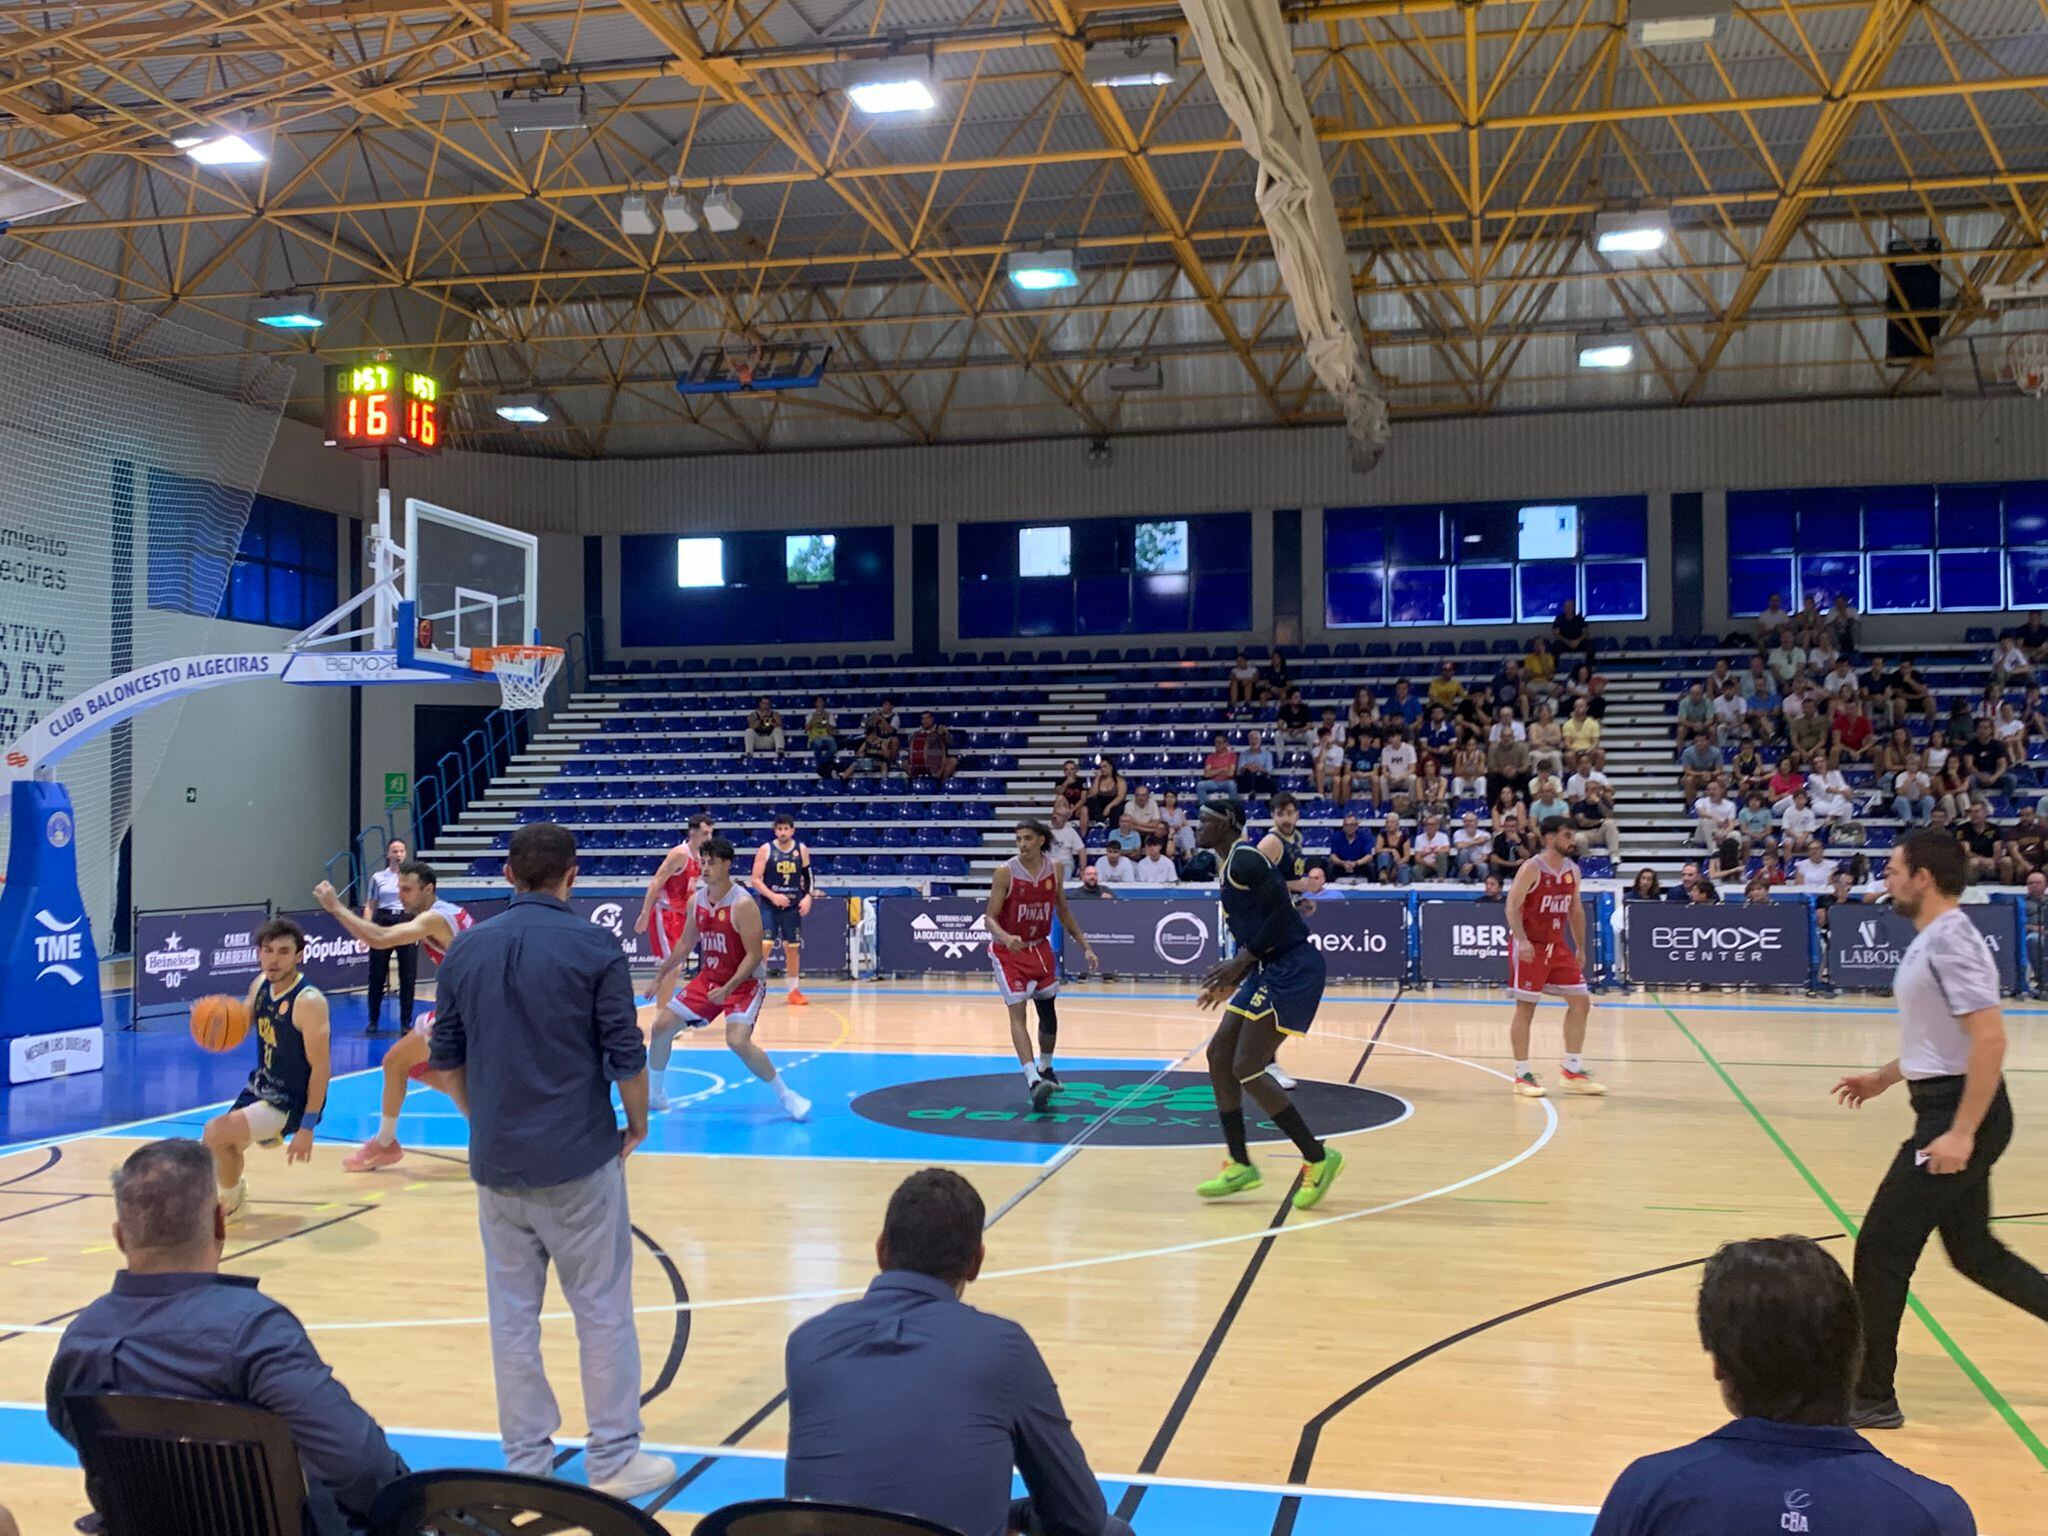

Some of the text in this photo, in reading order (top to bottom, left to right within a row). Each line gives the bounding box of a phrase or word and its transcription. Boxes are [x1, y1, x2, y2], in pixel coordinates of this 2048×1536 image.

[348, 394, 388, 436] 16
[411, 400, 435, 446] 16
[21, 661, 65, 703] DE
[48, 656, 270, 737] CLUB BALONCESTO ALGECIRAS
[922, 930, 954, 942] BOUTIQUE
[955, 931, 964, 940] DE
[1452, 924, 1512, 947] IBER
[35, 932, 82, 963] TME
[1453, 944, 1498, 959] Energía
[1668, 950, 1763, 962] CENTER
[149, 955, 197, 969] Heineken
[1781, 1511, 1809, 1532] CBA
